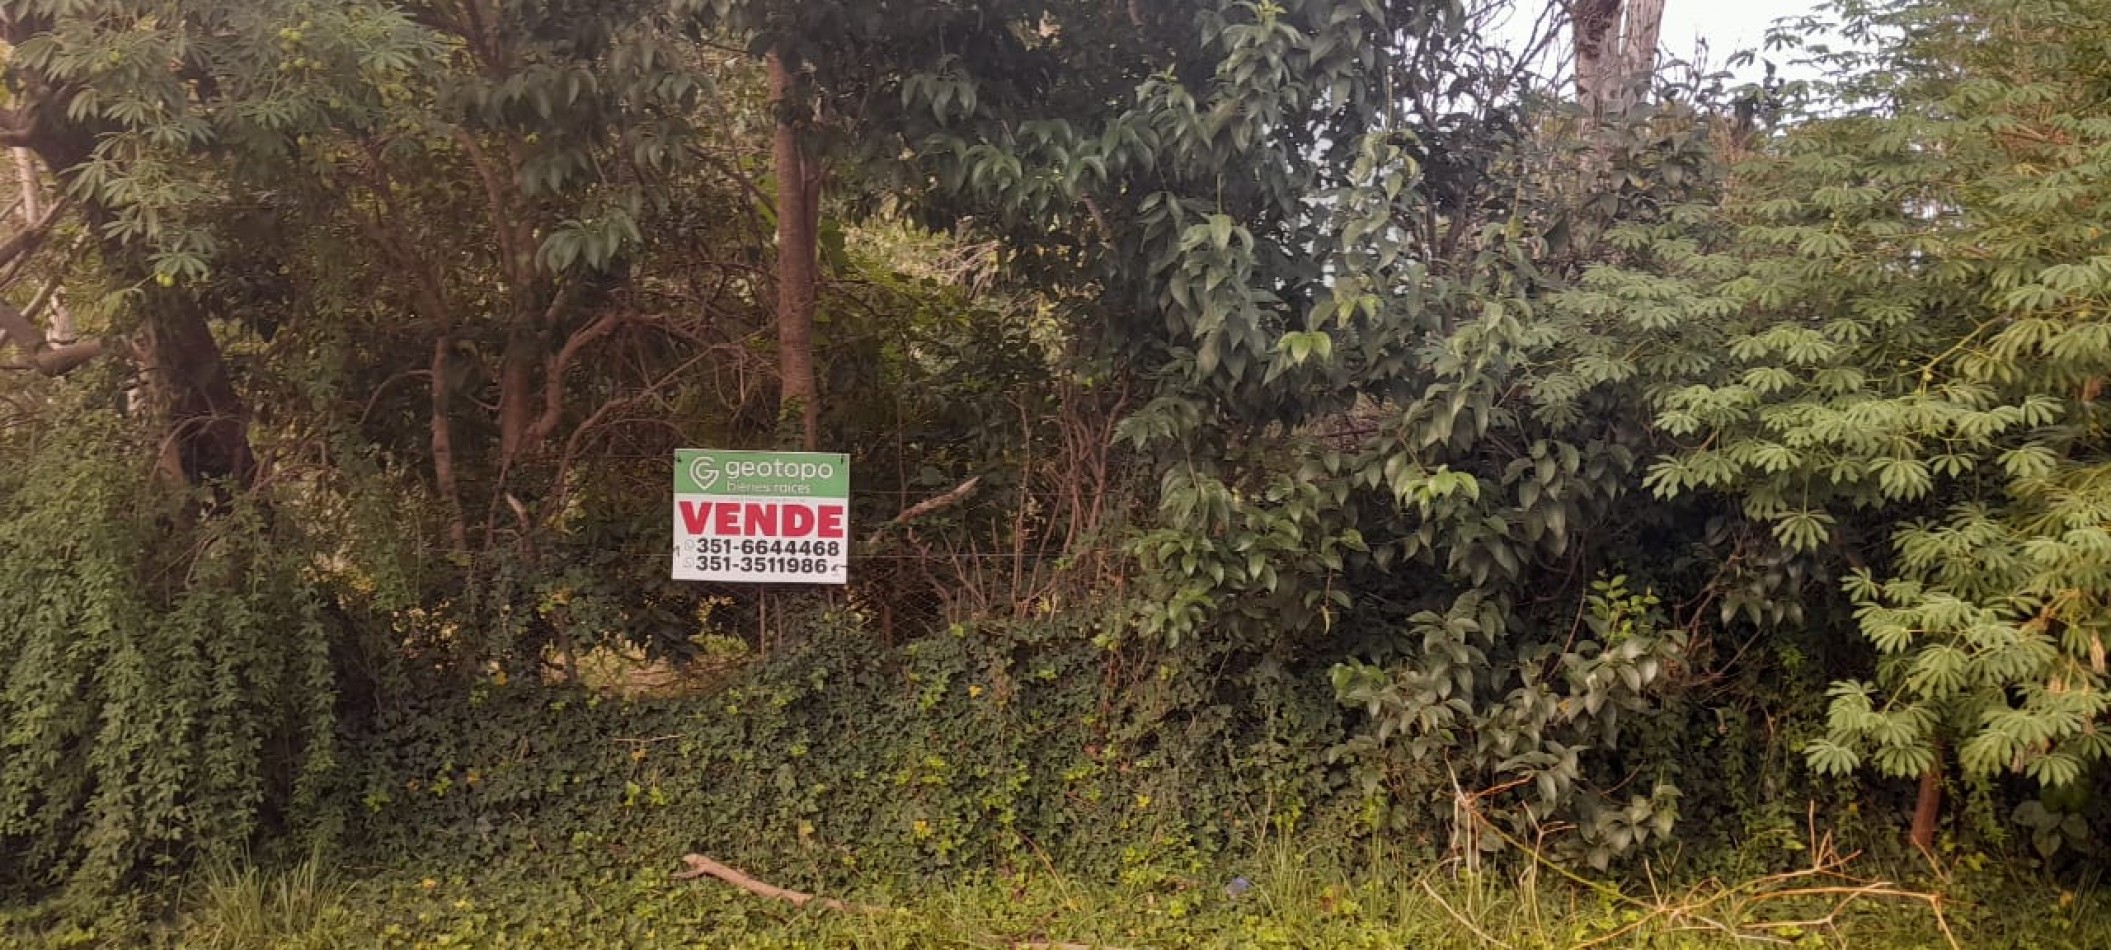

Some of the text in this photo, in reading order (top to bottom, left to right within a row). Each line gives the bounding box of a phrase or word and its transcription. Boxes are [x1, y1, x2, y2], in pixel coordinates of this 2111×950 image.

[725, 459, 833, 480] geotopo
[678, 501, 844, 538] VENDE
[696, 537, 839, 556] 351-6644468
[695, 556, 827, 573] 351-3511986
